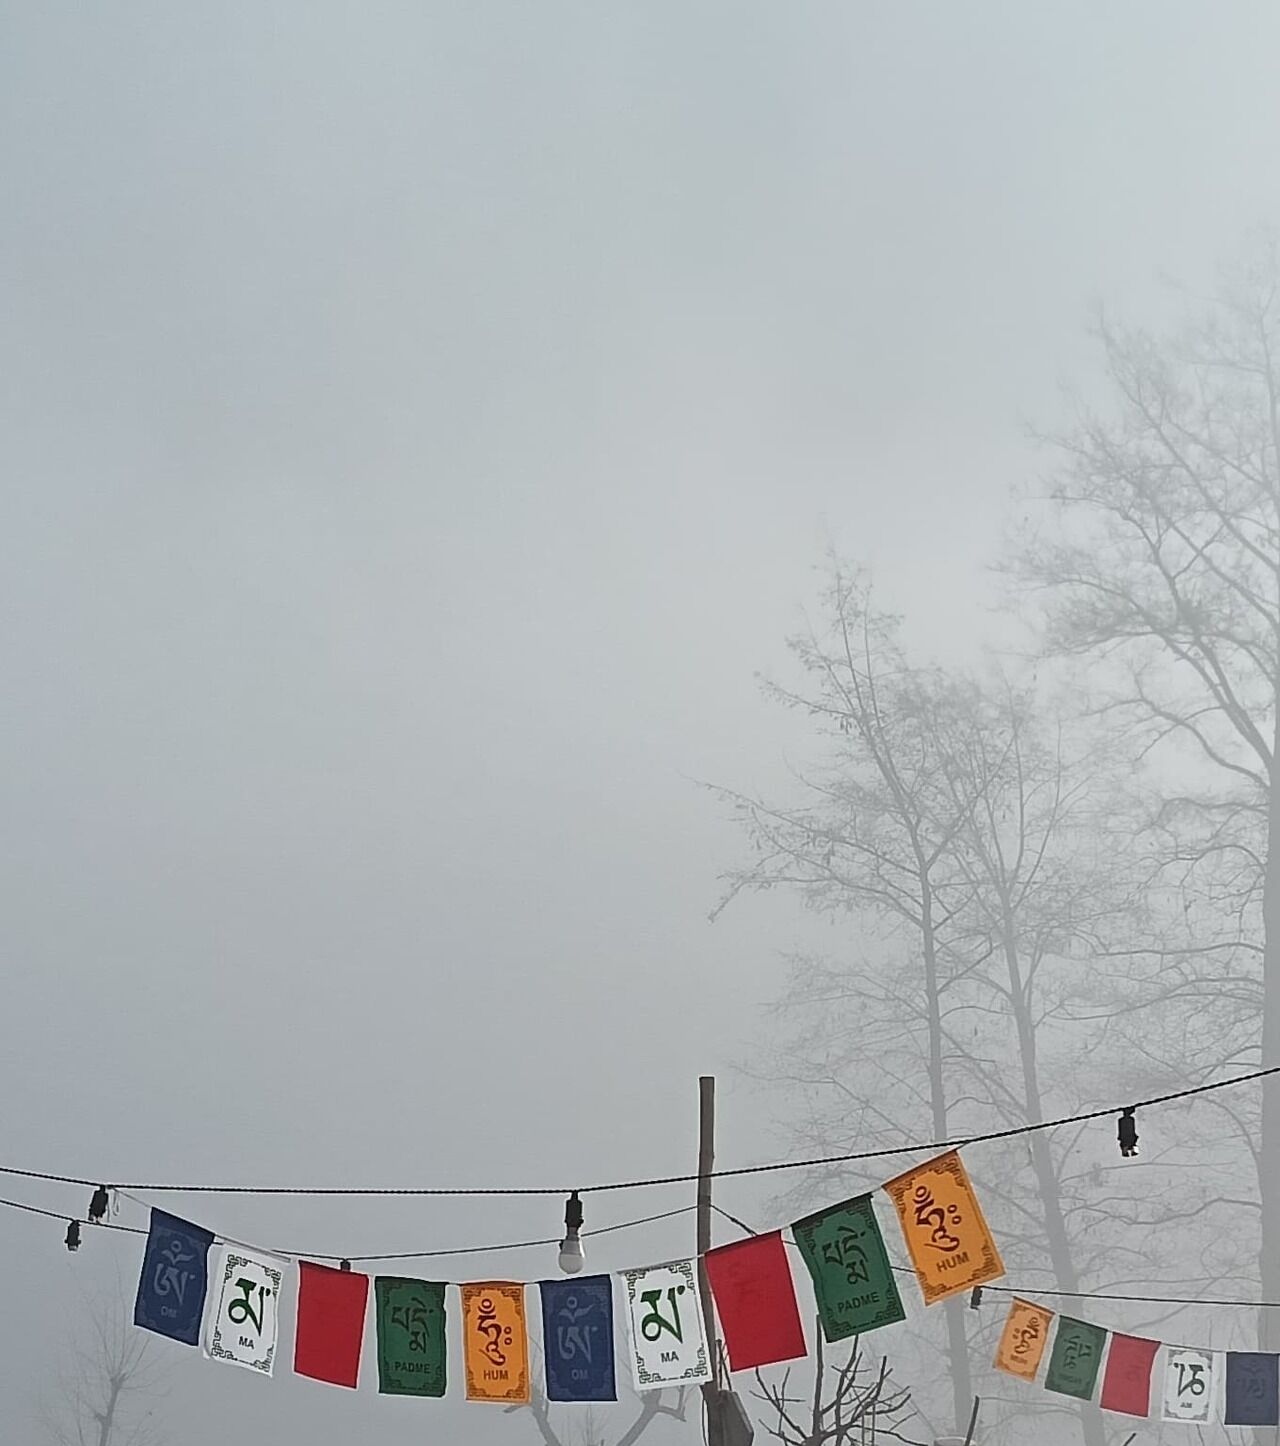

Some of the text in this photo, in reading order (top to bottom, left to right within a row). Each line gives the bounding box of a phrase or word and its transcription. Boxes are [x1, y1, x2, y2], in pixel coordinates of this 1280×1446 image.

[935, 1251, 971, 1273] HUM
[837, 1291, 880, 1313] PADME
[238, 1335, 255, 1350] MA
[660, 1351, 680, 1363] MA
[394, 1361, 432, 1375] PADME
[483, 1369, 509, 1381] HUM
[571, 1368, 589, 1381] OM
